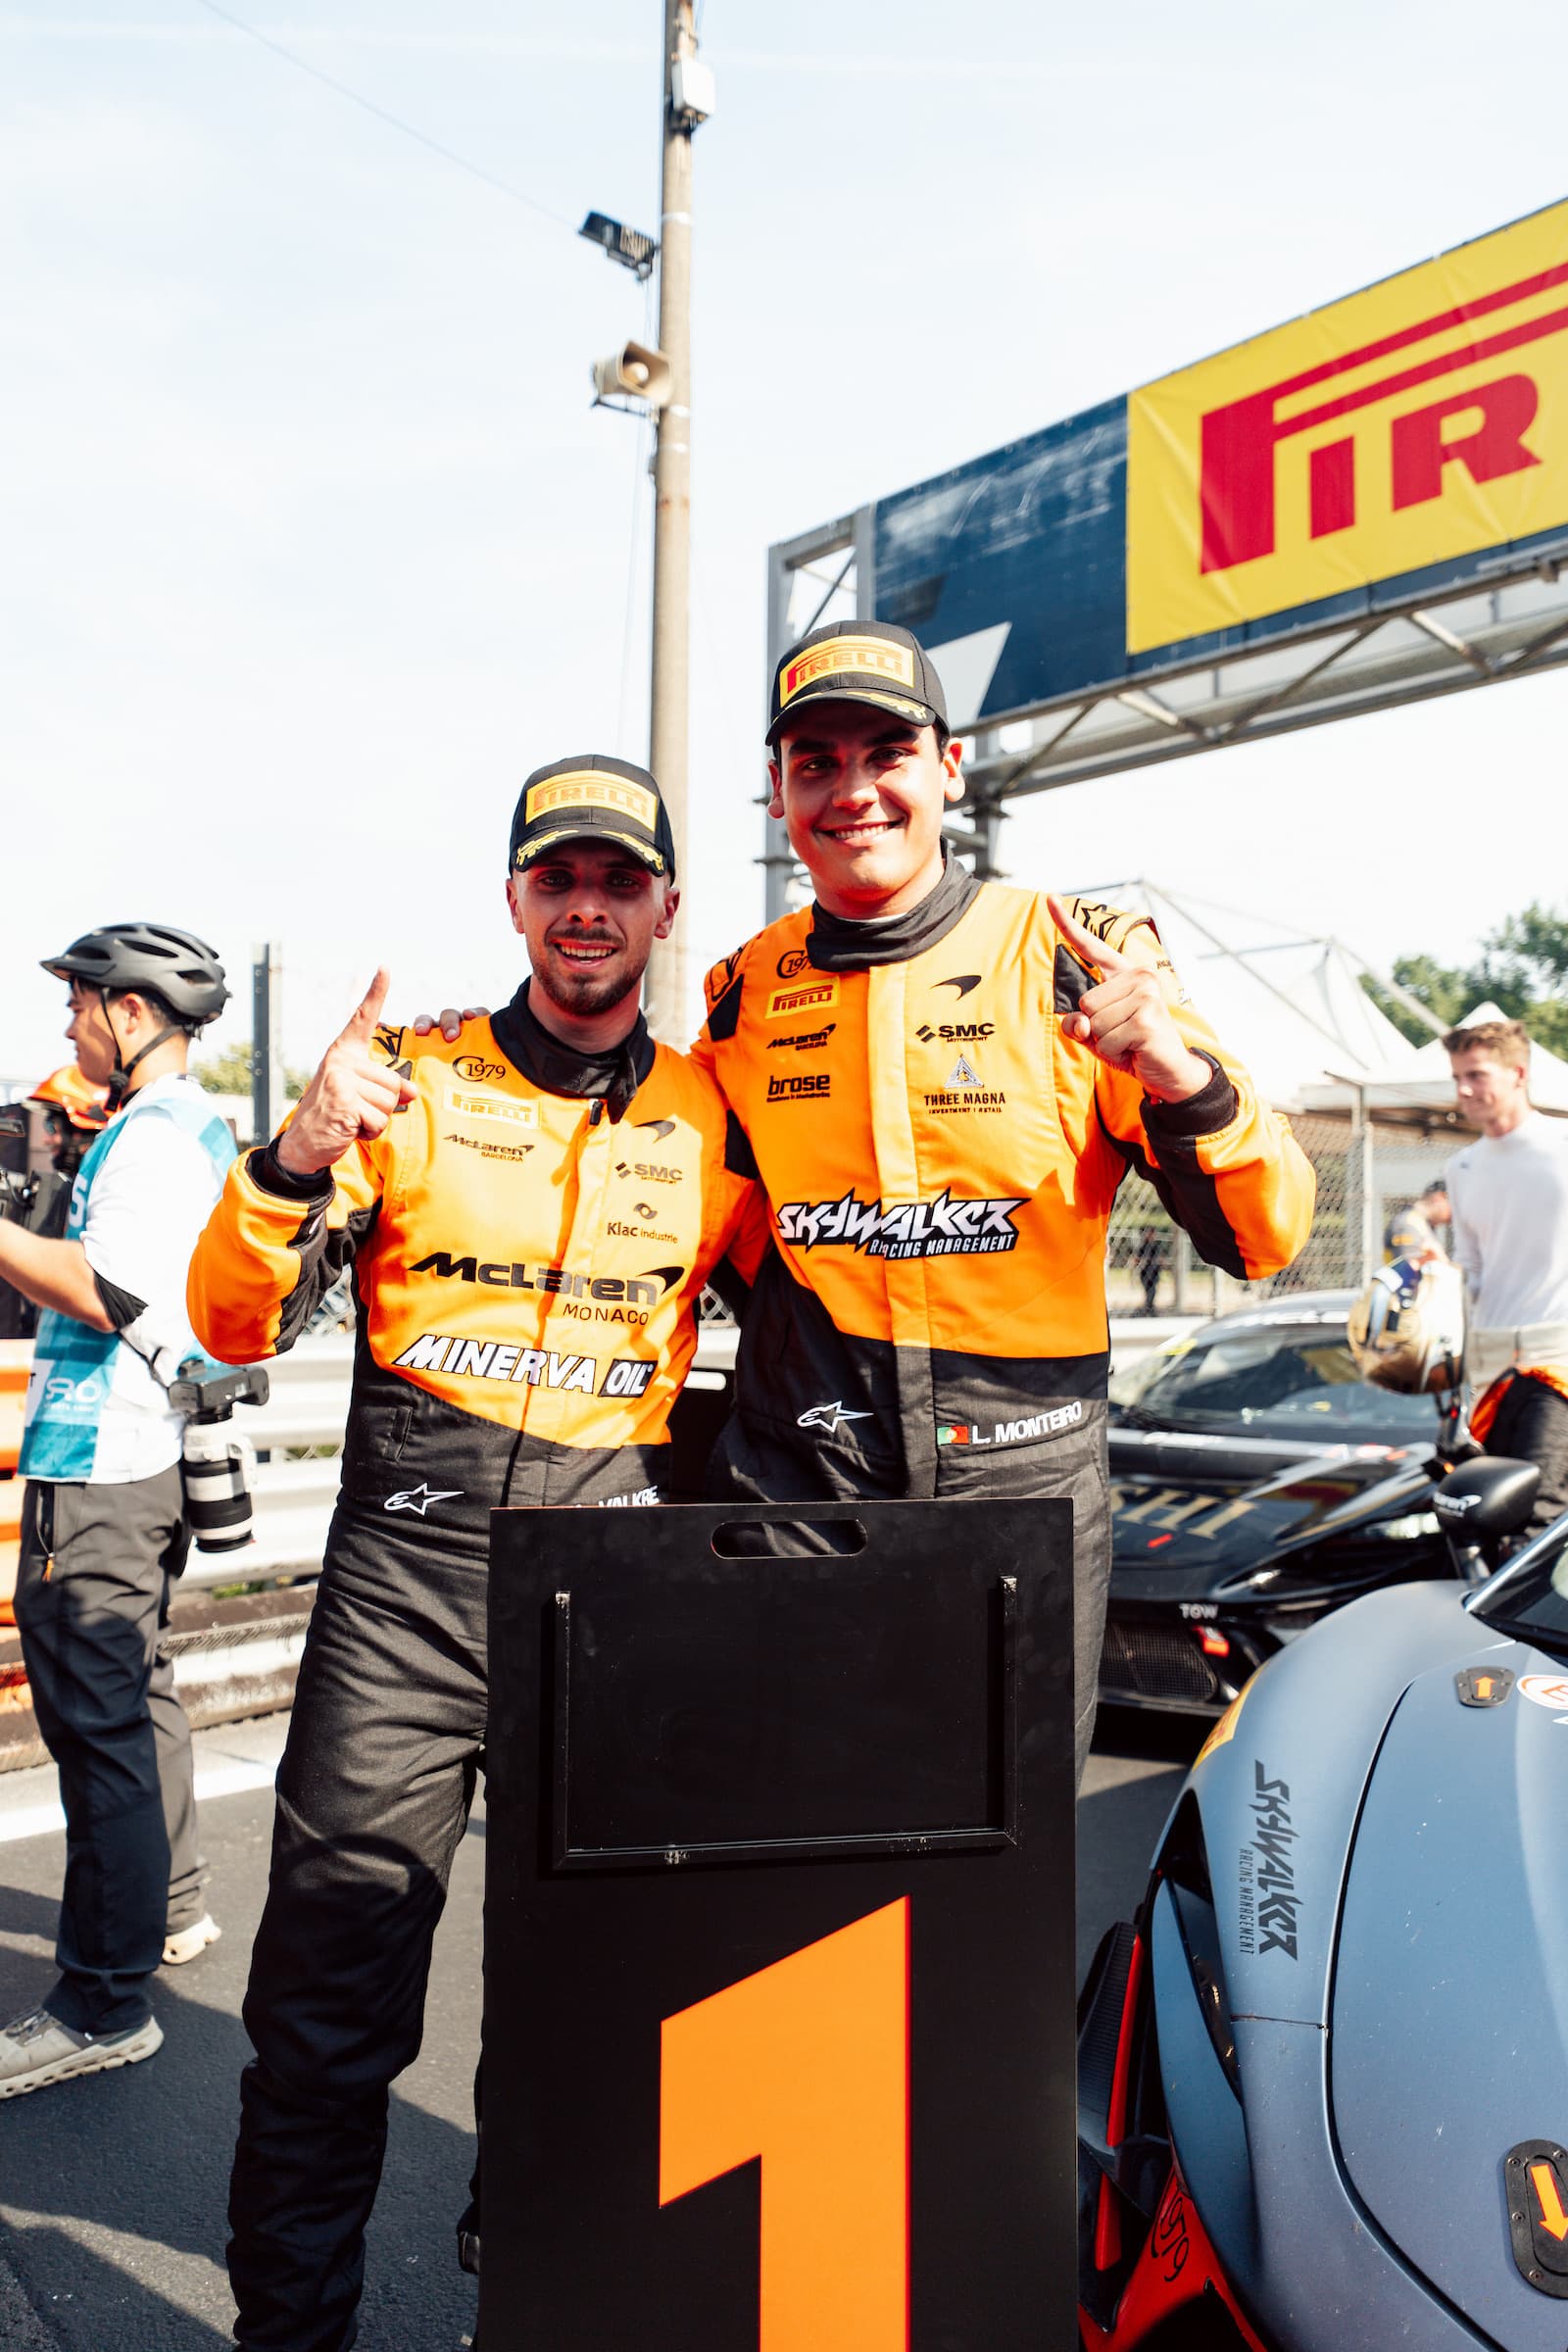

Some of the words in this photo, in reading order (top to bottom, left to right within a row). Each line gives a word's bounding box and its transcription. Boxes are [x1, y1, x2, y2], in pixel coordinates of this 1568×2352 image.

[786, 643, 905, 694] PIRELLI
[532, 776, 649, 817] PIRELLI
[772, 984, 834, 1011] PIRELLI
[766, 1031, 828, 1050] McLaren
[938, 1022, 996, 1038] SMC
[768, 1074, 830, 1096] brose
[453, 1093, 533, 1123] PIRELLI
[924, 1093, 959, 1106] THREE
[964, 1092, 1005, 1105] MAGNA
[444, 1134, 524, 1156] McLaren
[480, 1152, 524, 1162] BARCELONA
[634, 1163, 683, 1182] SMC
[777, 1190, 1029, 1248] SKYWALKER
[607, 1222, 638, 1238] Klac
[640, 1228, 679, 1245] industrie
[869, 1240, 921, 1259] RACING
[925, 1233, 1015, 1255] MANAGEMENT
[408, 1252, 658, 1306] McLaren
[563, 1302, 650, 1326] MONACO
[392, 1334, 597, 1395] MINERVA
[606, 1361, 654, 1396] OIL
[971, 1425, 991, 1445] L.
[995, 1400, 1082, 1444] MONTEIRO
[1179, 1602, 1219, 1619] TOW
[1239, 1848, 1253, 1884] RACING
[1248, 1759, 1303, 1961] SKYWALKER
[1239, 1886, 1254, 1955] MANAGEMENT
[659, 1894, 909, 2352] 1
